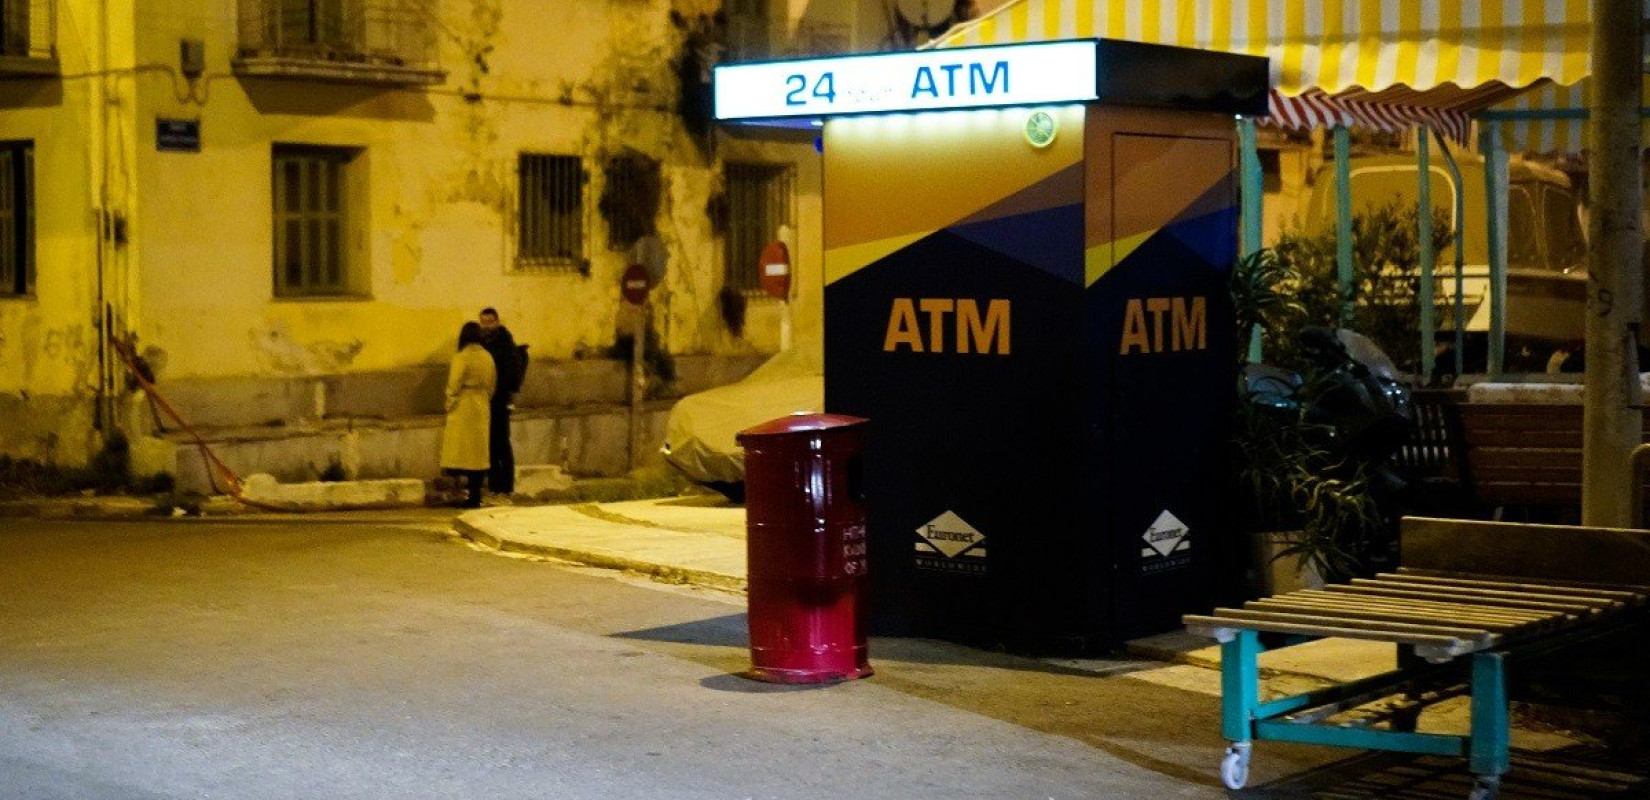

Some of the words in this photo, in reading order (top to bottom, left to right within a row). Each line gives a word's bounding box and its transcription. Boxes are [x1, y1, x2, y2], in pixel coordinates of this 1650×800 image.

[785, 73, 836, 106] 24
[911, 60, 1010, 98] ATM
[883, 297, 1011, 355] ATM
[1119, 297, 1207, 355] ATM
[927, 524, 974, 543] Euronet
